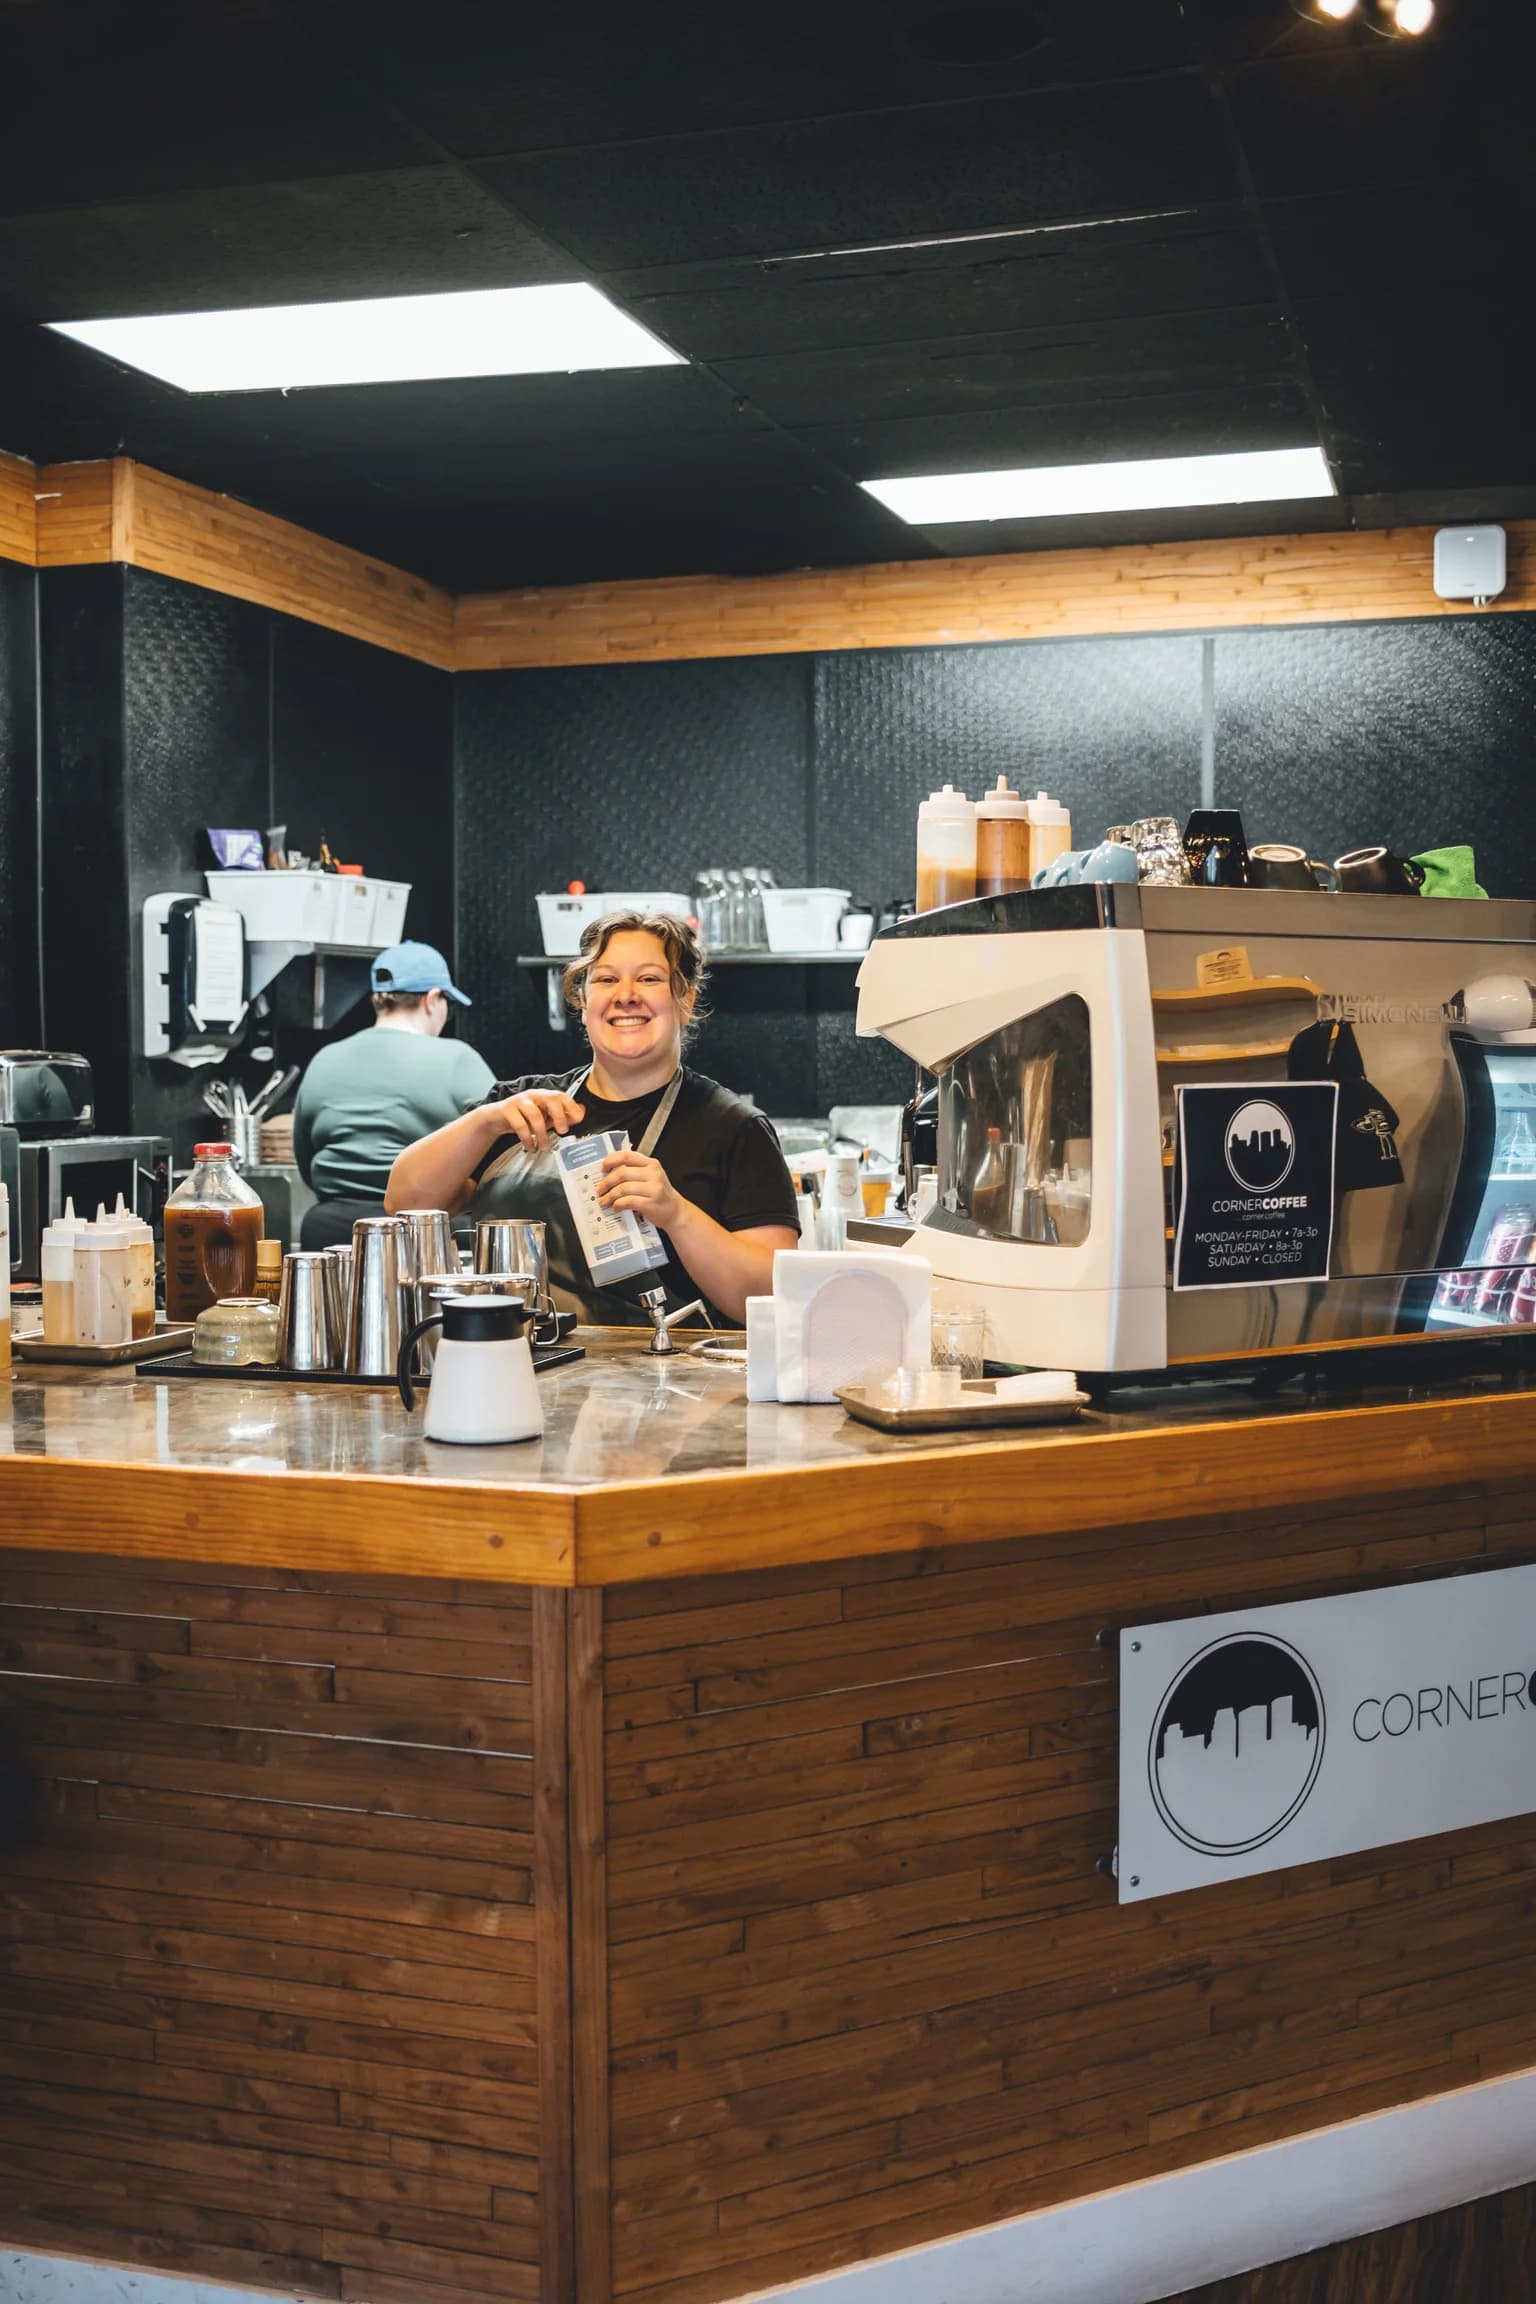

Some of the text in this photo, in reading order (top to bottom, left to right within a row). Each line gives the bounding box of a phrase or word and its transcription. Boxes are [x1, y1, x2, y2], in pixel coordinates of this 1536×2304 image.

[1212, 1196, 1308, 1213] CORNERCOFFEE
[1195, 1227, 1318, 1243] MONDAY-FRIDAY 7a-3p
[1210, 1240, 1303, 1255] SATURDAY 8a-3p
[1208, 1252, 1302, 1267] SUNDAY CLOSED
[1353, 1670, 1536, 1742] CORNER
